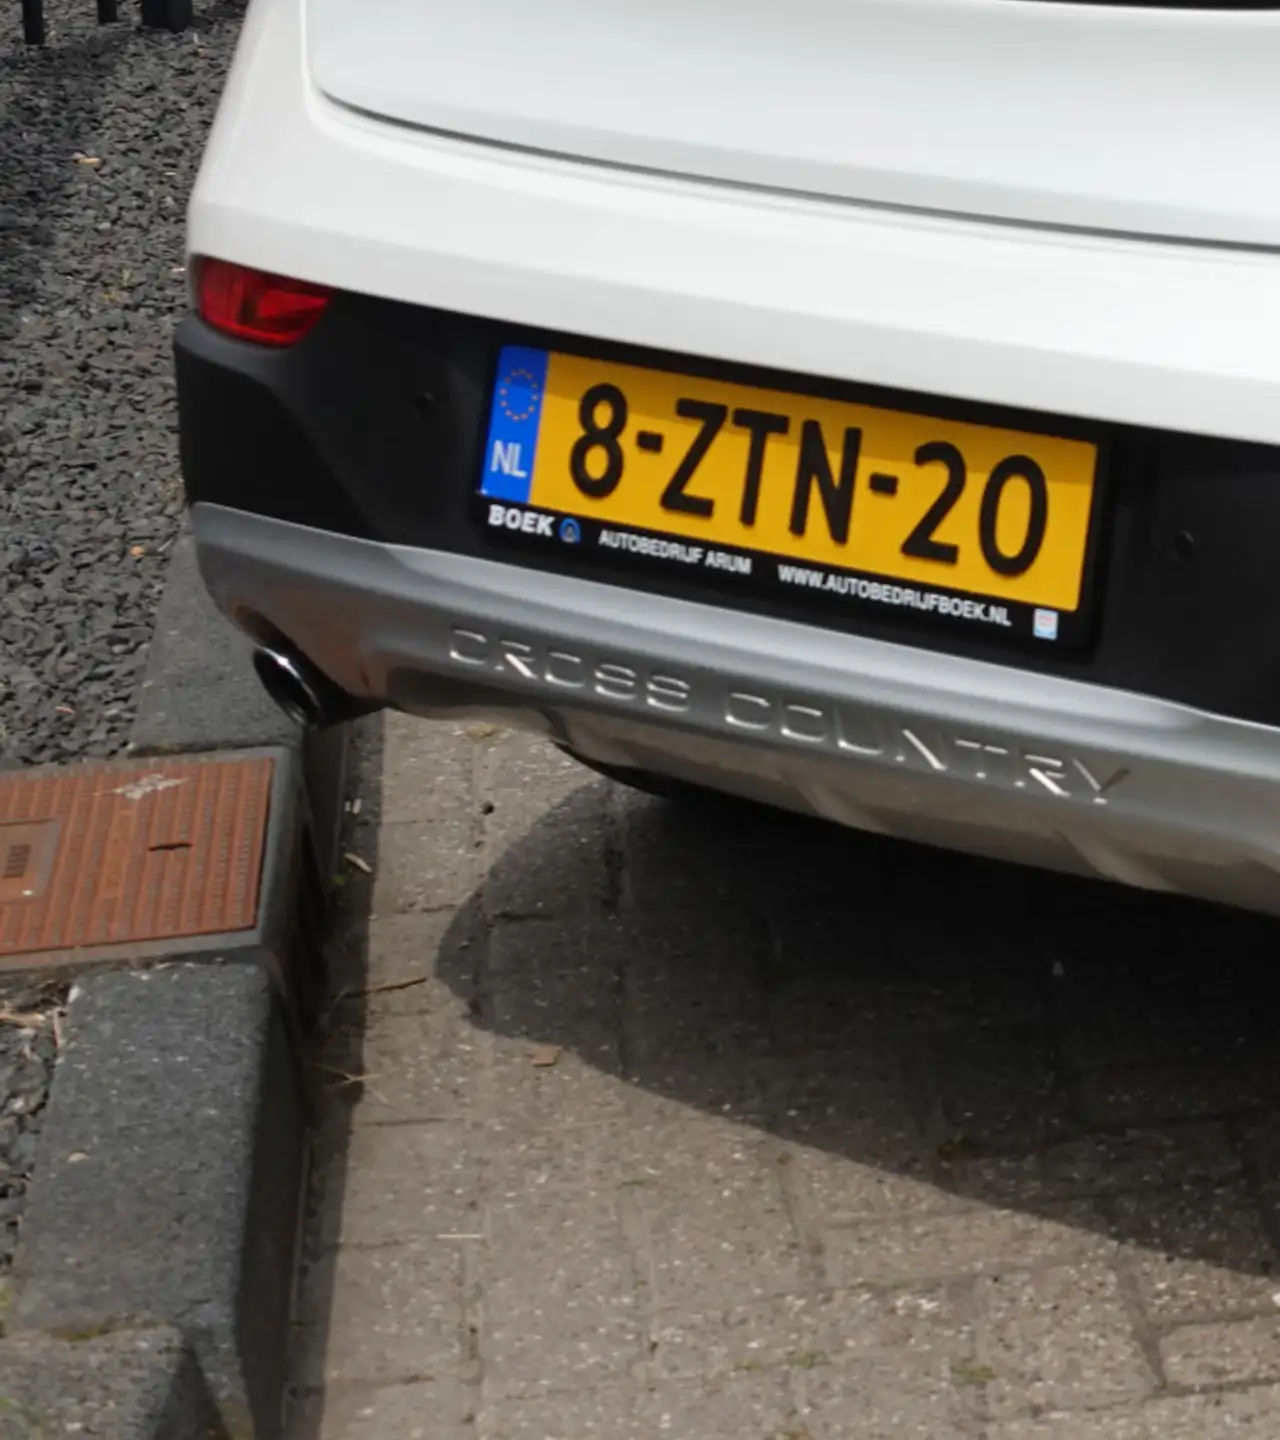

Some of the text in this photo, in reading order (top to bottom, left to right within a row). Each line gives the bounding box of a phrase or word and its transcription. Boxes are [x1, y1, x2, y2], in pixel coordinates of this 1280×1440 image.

[490, 439, 528, 479] NL
[569, 382, 1049, 579] 8-ZTN-20
[488, 504, 555, 537] BOEK
[598, 528, 754, 574] AUTOBEDRIJF ARUM
[777, 563, 1013, 627] WWW.AUTOBEDRIJFBOEK.NL
[449, 628, 1131, 805] CROSS COUNTRY
